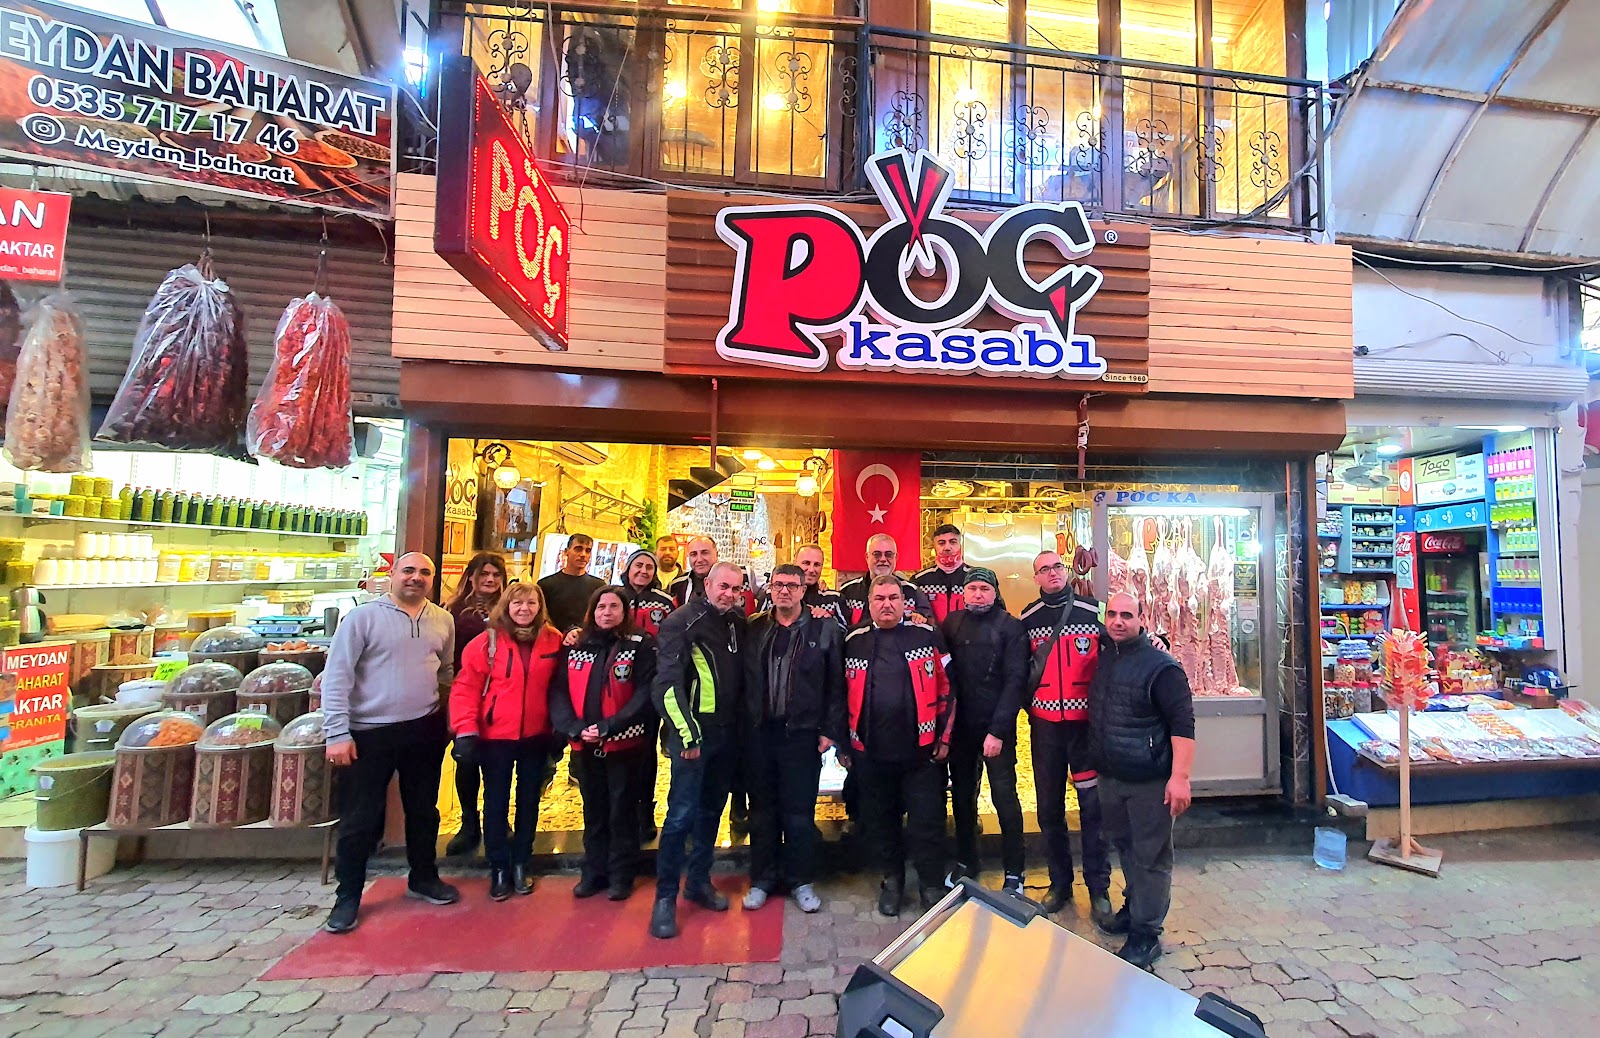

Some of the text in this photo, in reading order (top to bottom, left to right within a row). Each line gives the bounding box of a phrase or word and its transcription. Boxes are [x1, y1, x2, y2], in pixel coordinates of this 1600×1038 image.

[187, 54, 383, 134] BAHARAT
[30, 77, 298, 154] 0535 717 17 46
[0, 240, 55, 259] AKTAR
[7, 650, 68, 671] MEYDAN
[16, 672, 64, 691] AHARAT
